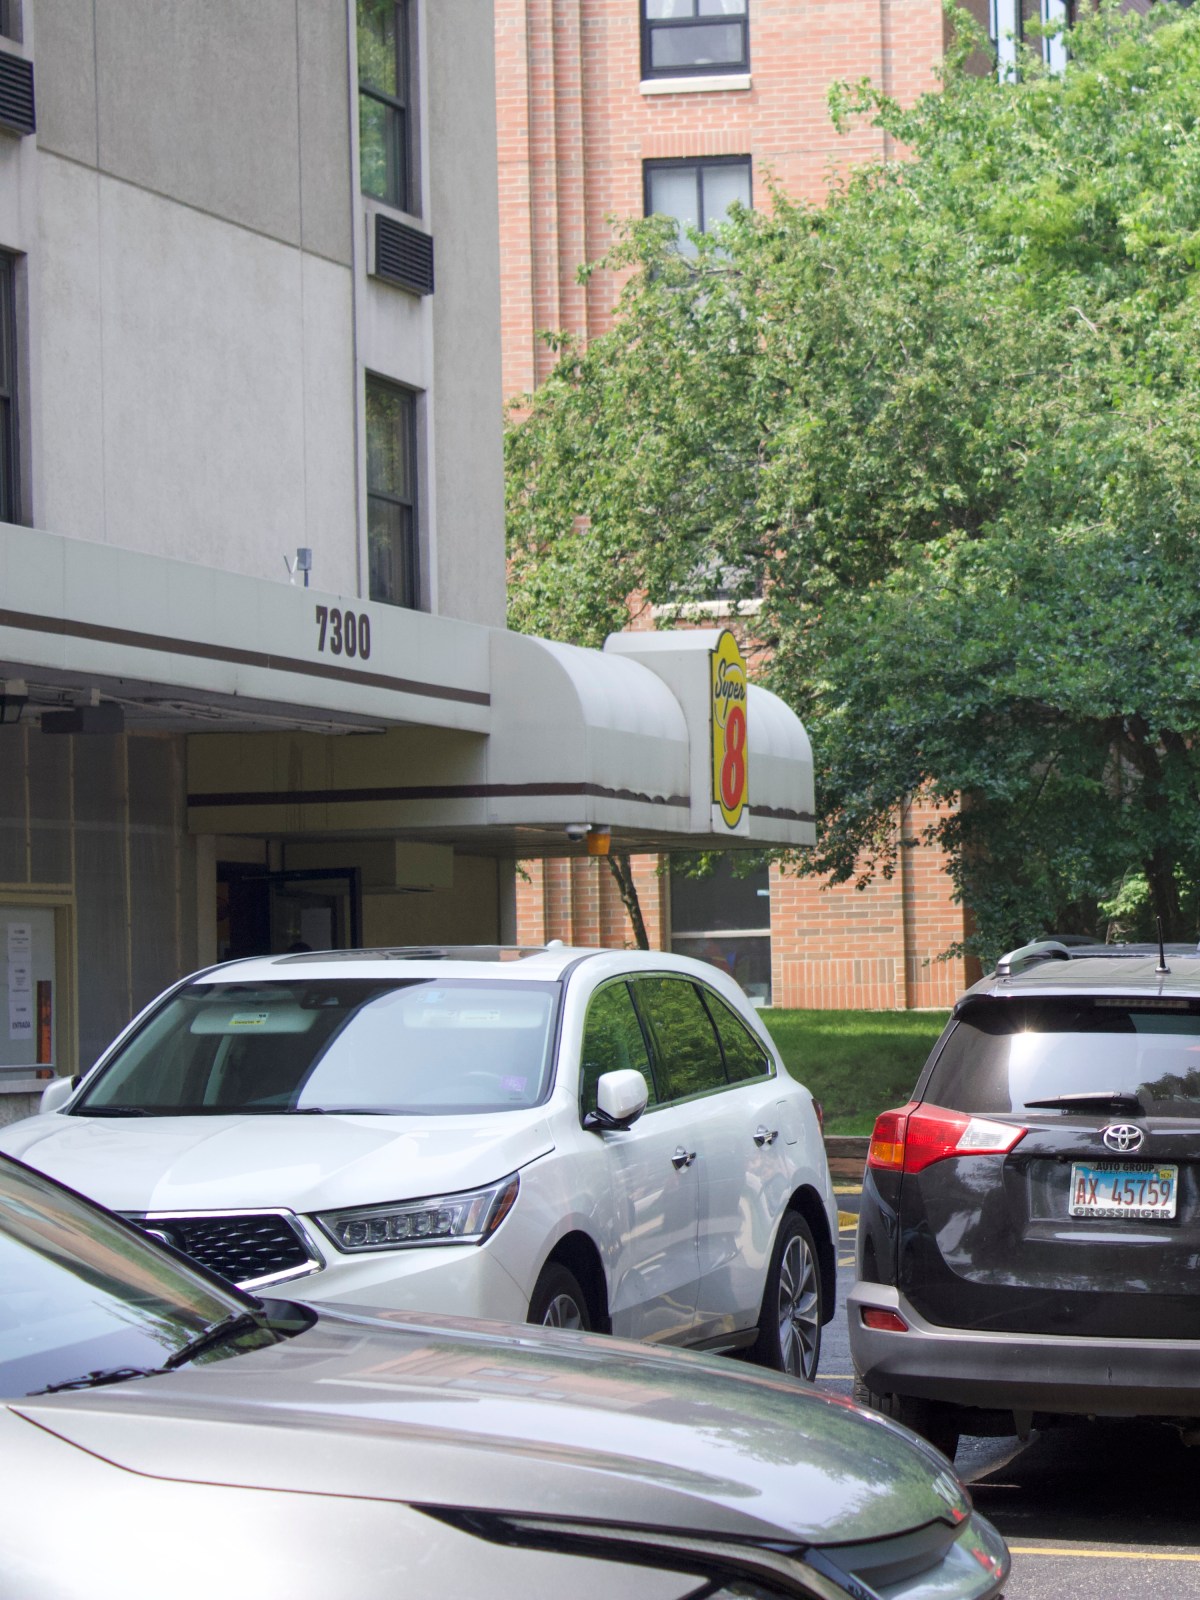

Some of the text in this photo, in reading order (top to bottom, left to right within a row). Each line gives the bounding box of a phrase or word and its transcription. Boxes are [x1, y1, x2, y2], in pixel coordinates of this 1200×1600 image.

[316, 605, 371, 660] 7300
[715, 658, 746, 719] Super
[721, 706, 746, 811] 8
[1096, 1163, 1154, 1173] AUTO GROUP
[1076, 1178, 1171, 1206] AX 45759
[1074, 1207, 1170, 1219] GROSSINGER
